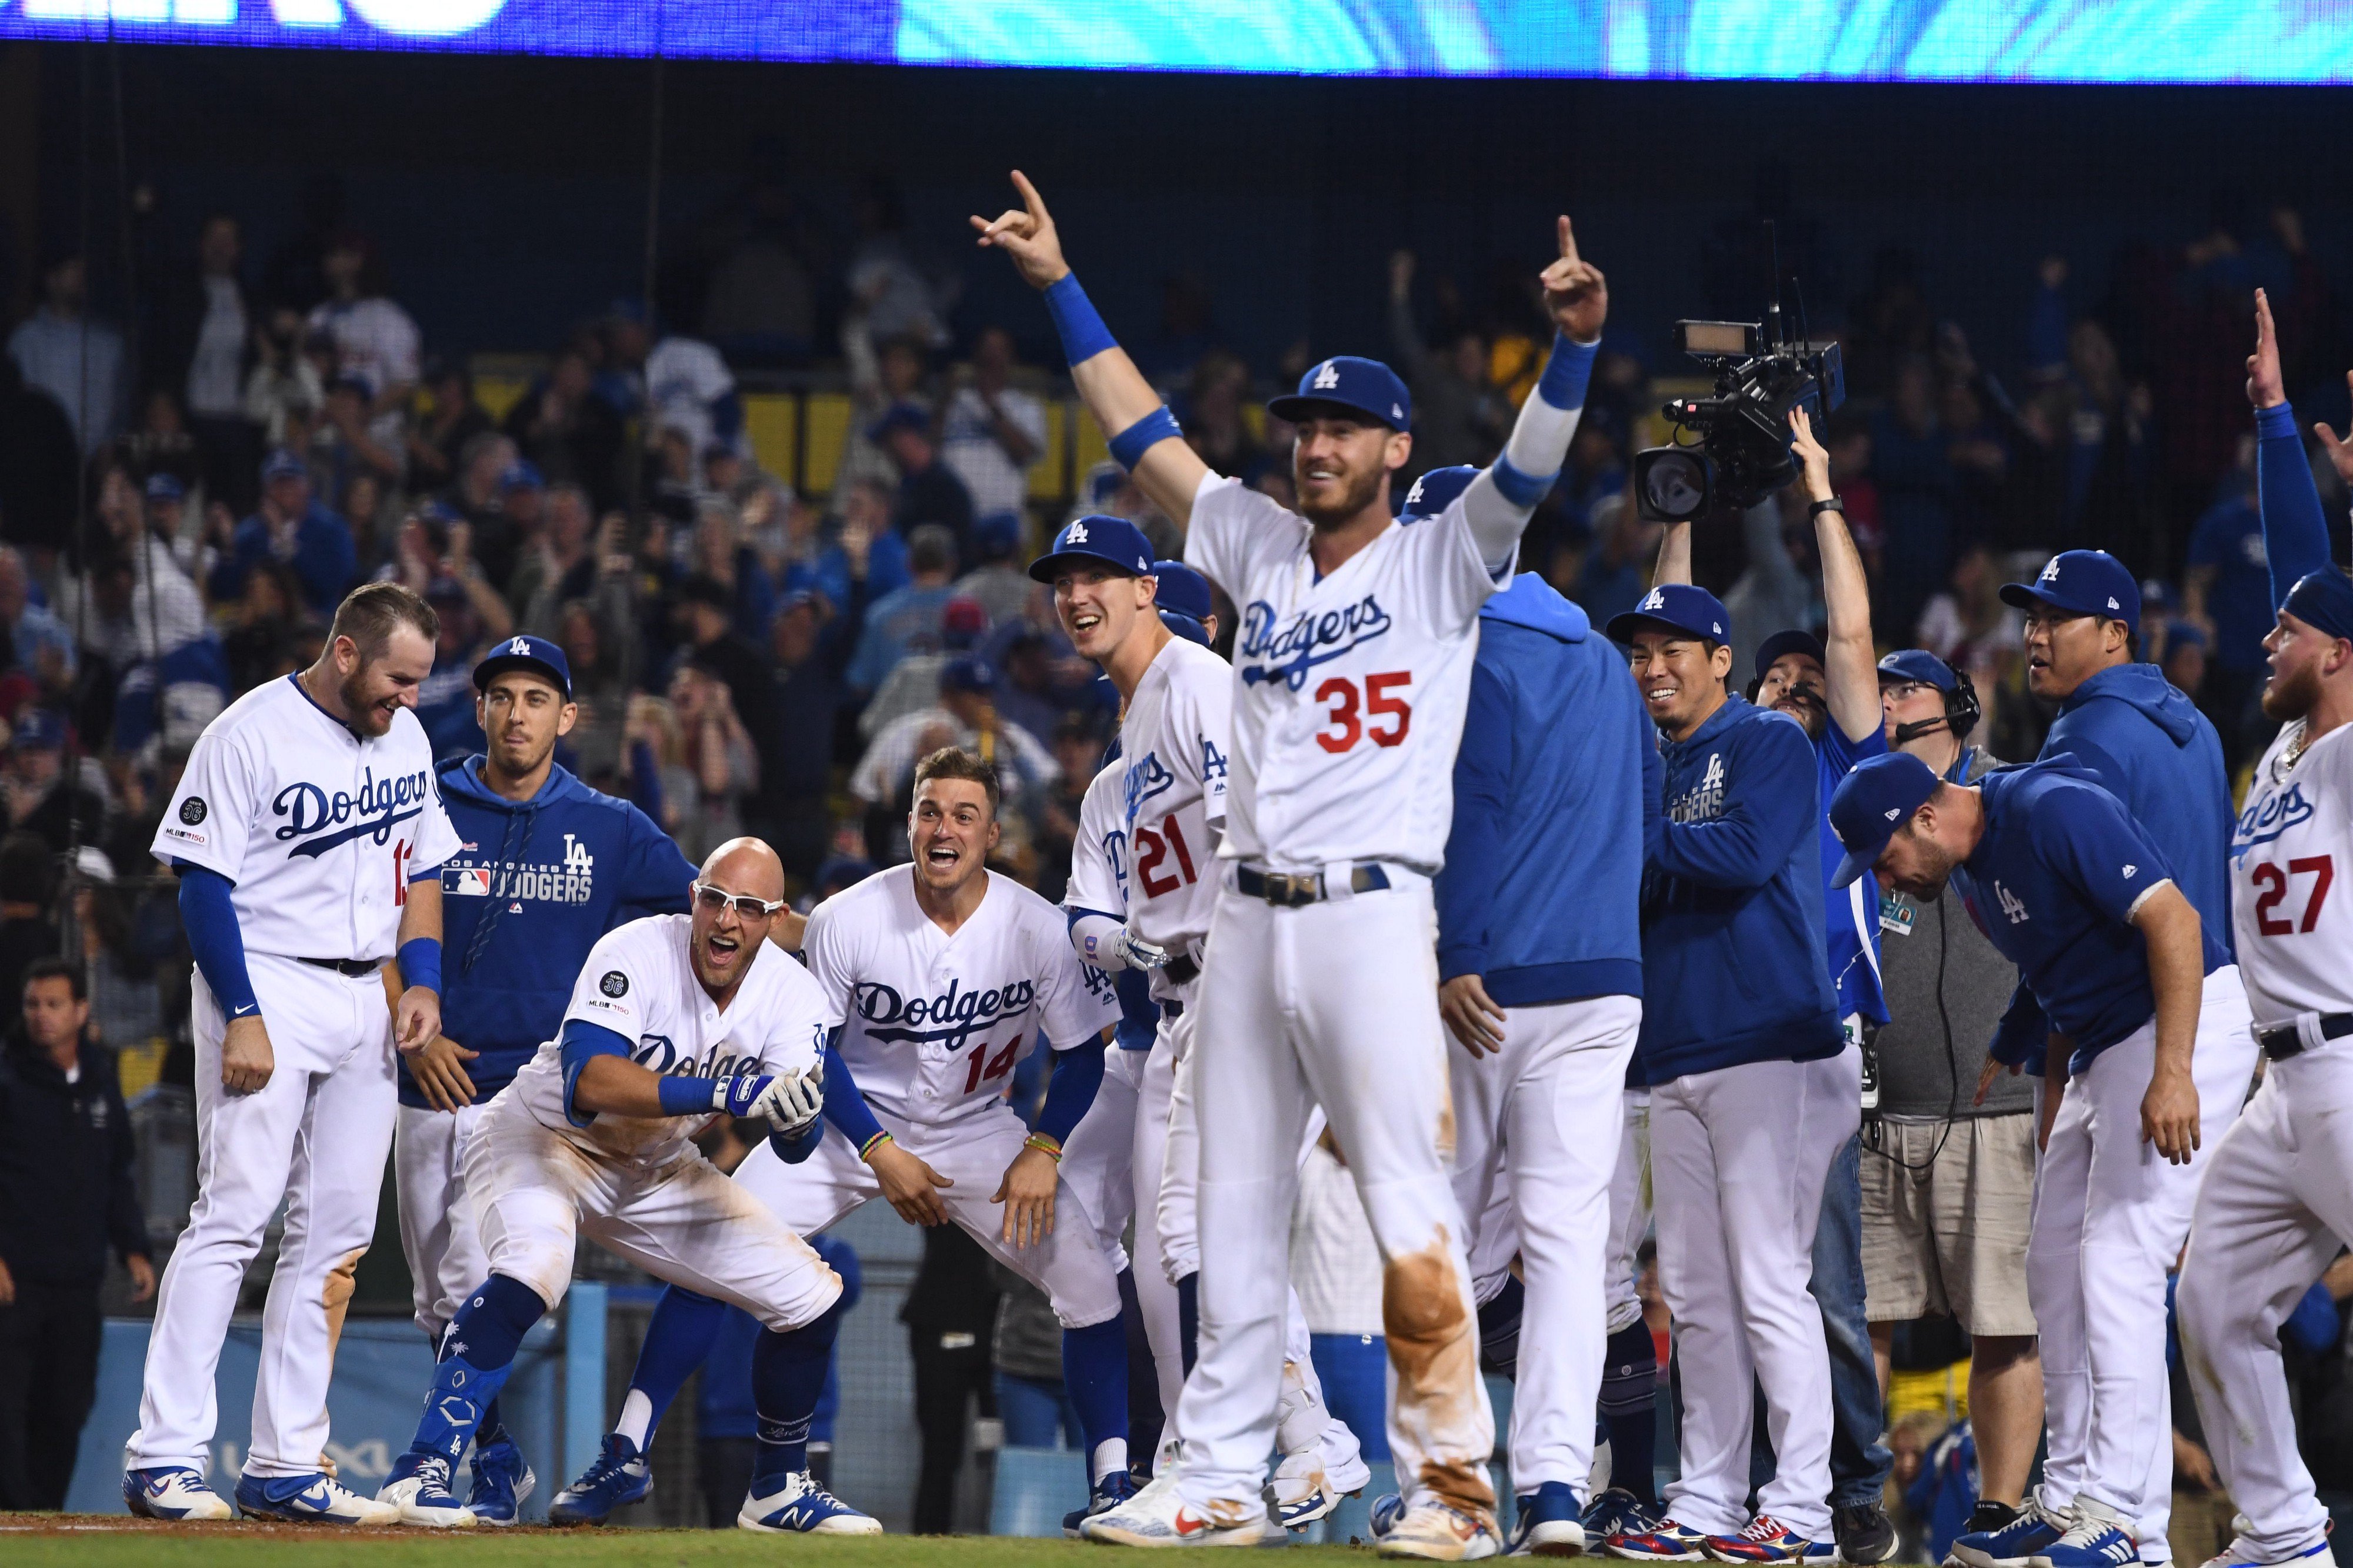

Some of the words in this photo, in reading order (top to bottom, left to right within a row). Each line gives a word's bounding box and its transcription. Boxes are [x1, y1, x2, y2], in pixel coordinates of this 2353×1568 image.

[1314, 359, 1340, 389] LA
[1066, 519, 1088, 545] LA
[2041, 555, 2060, 581] LA
[1645, 587, 1665, 610] LA
[509, 636, 531, 656] LA
[1315, 670, 1412, 753] 35
[1198, 733, 1228, 782] A
[1702, 753, 1724, 791] LA
[183, 805, 202, 821] 36
[165, 828, 181, 837] MLB
[191, 833, 205, 843] 150
[442, 859, 472, 868] LOS
[564, 833, 593, 876] LA
[1134, 813, 1198, 899] 21
[1995, 880, 2029, 923] LA
[2252, 854, 2334, 936] 27
[604, 978, 624, 995] 36
[617, 1005, 629, 1015] 150
[856, 978, 1034, 1051] Dodgers
[964, 1033, 1023, 1095] 14
[450, 1434, 461, 1456] LA
